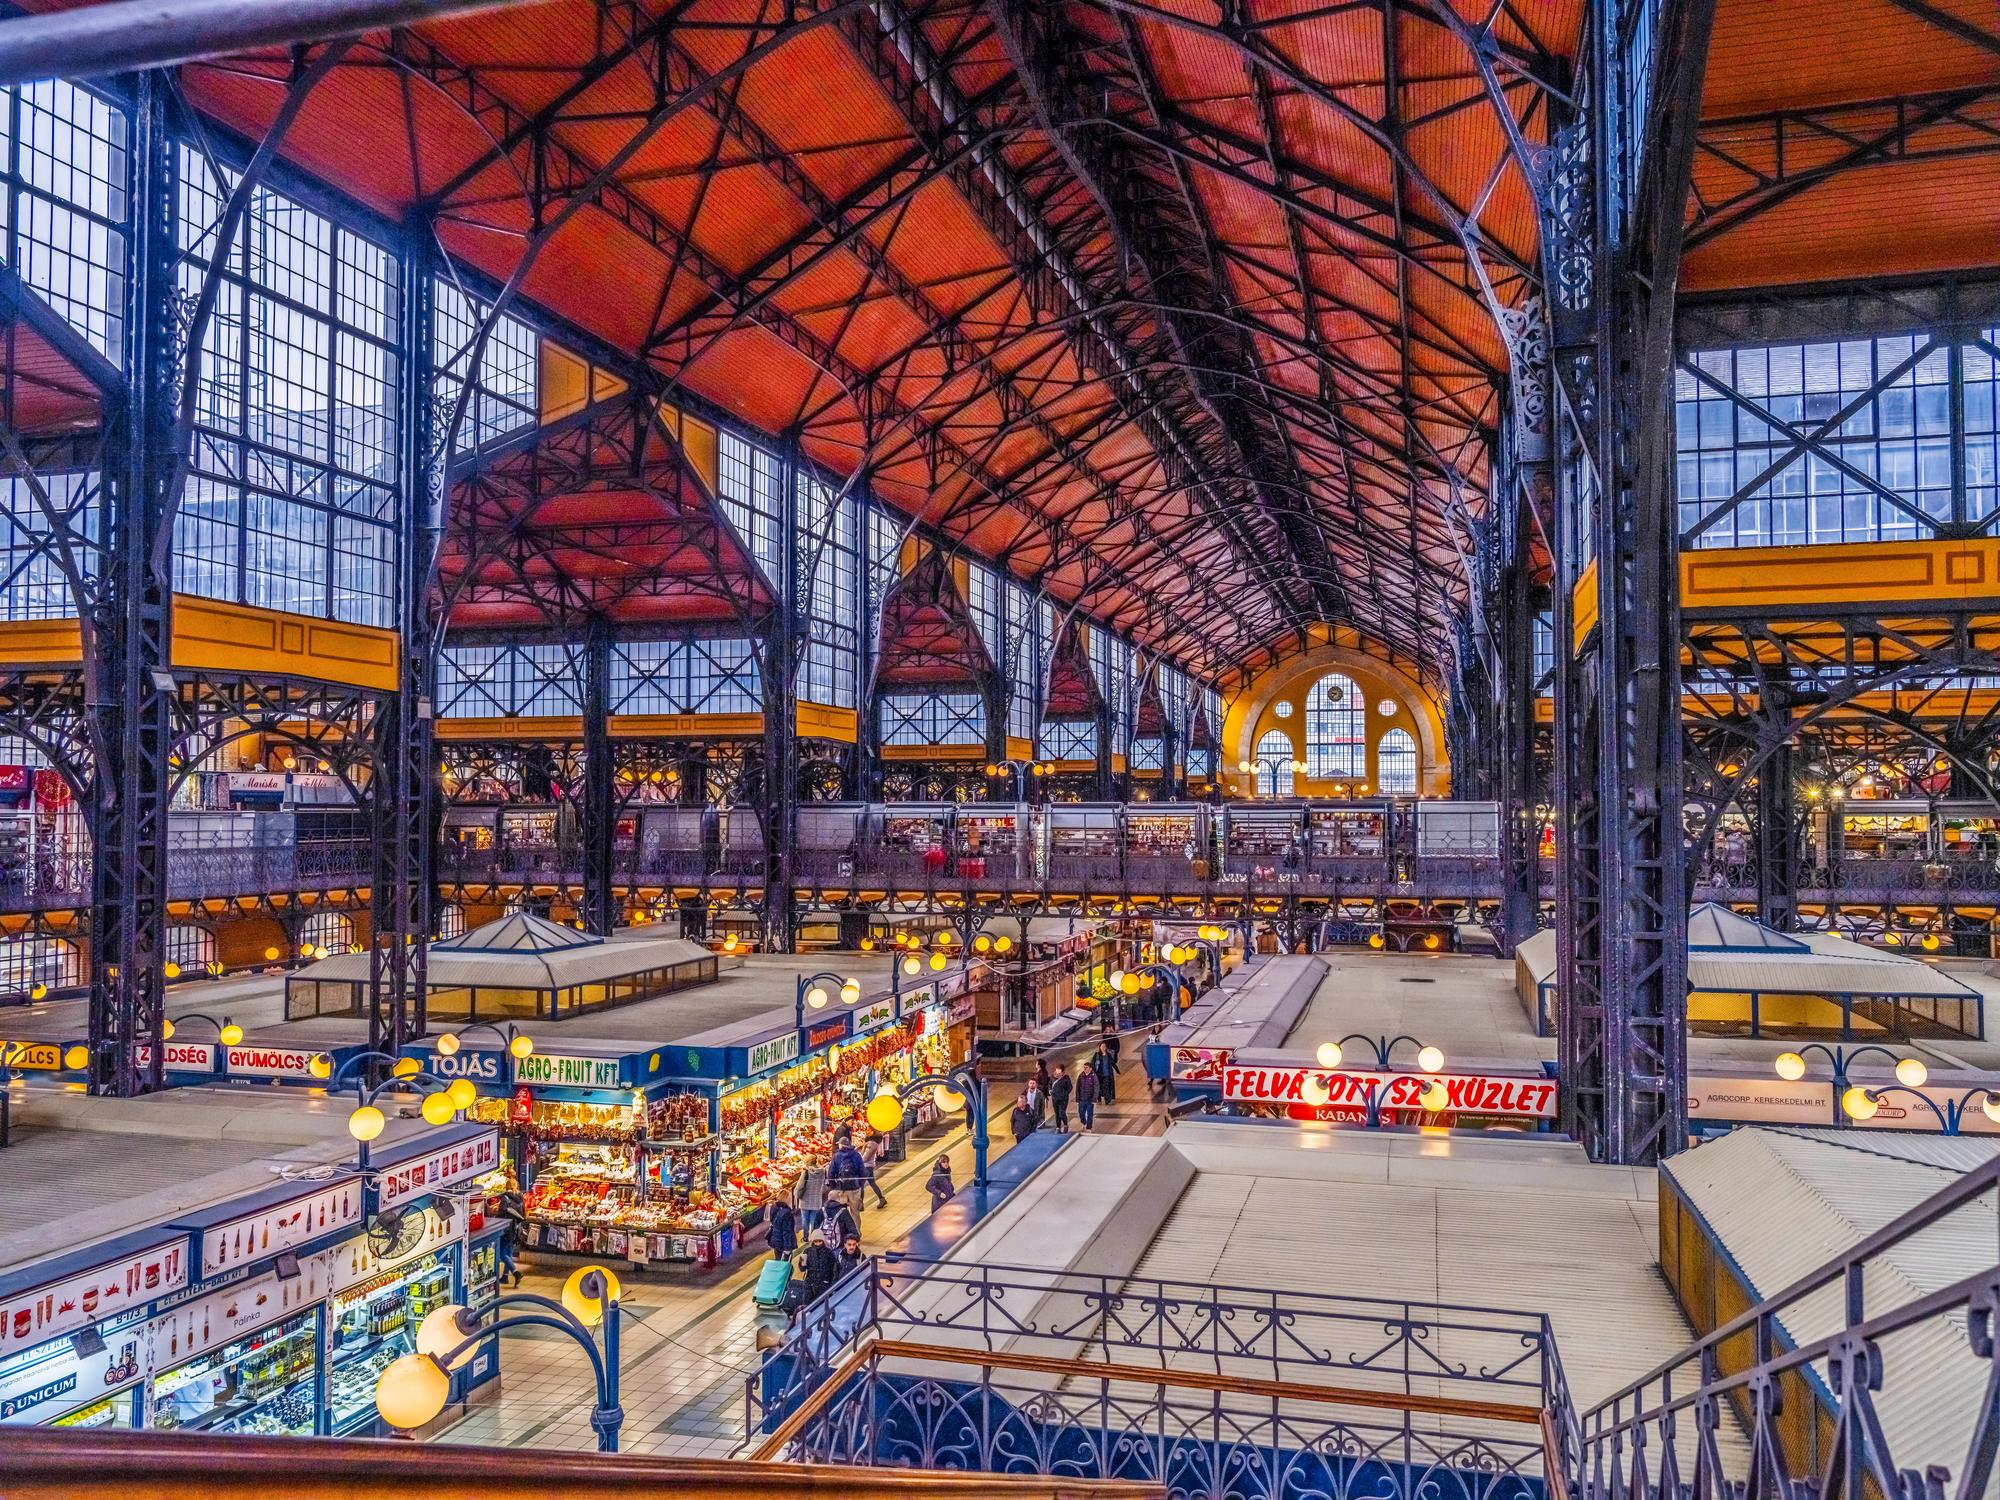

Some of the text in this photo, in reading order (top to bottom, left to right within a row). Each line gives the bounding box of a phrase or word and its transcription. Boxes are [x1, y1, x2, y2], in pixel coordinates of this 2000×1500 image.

[141, 1046, 207, 1064] ZLDSÉG
[229, 1050, 304, 1070] GYÜMÖLCS
[428, 1053, 498, 1078] TOJÁS
[752, 1038, 785, 1070] AGRO-FRUIT
[518, 1057, 620, 1087] AGRO-FRUIT KFT.
[1225, 1068, 1555, 1113] FELVÁOTT SZKÜZLET
[1707, 1094, 1751, 1103] AGROCORP
[1754, 1096, 1813, 1106] KERESKEDELMI
[1316, 1109, 1391, 1125] KABANS
[17, 1377, 75, 1409] UNICUM
